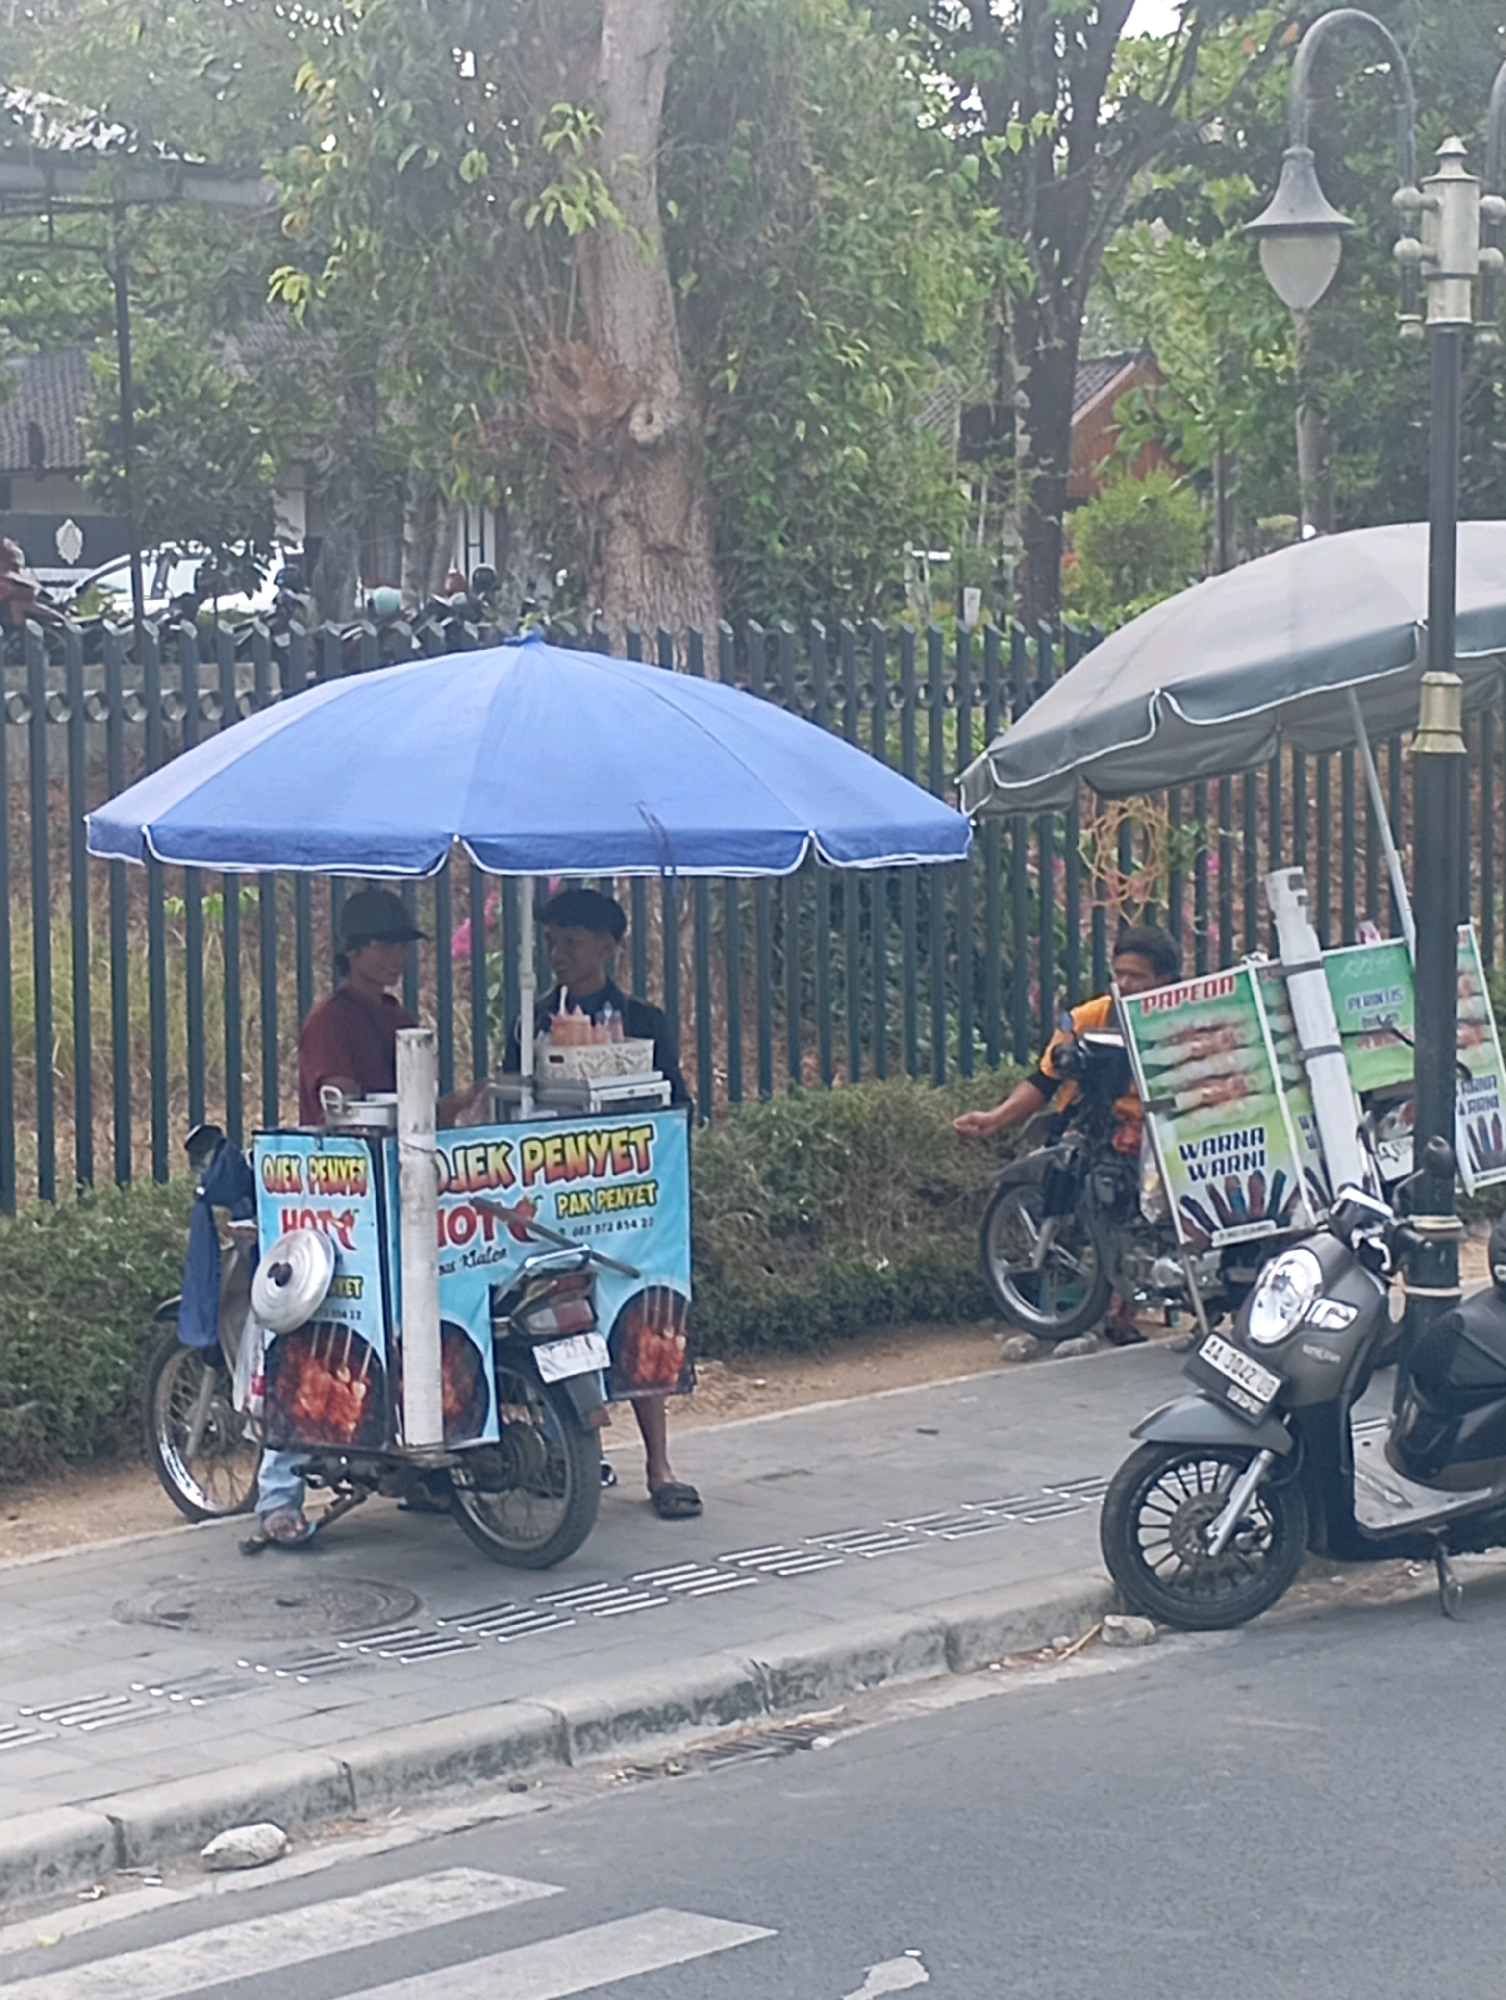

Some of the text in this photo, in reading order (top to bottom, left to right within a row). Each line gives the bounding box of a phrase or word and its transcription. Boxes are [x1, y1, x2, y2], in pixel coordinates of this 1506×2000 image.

[519, 1119, 656, 1188] PENYET
[1179, 1126, 1266, 1162] WARNA
[261, 1153, 368, 1198] OJEK PENYET
[1187, 1149, 1267, 1183] WARNI
[554, 1179, 659, 1220] PAK PENYET
